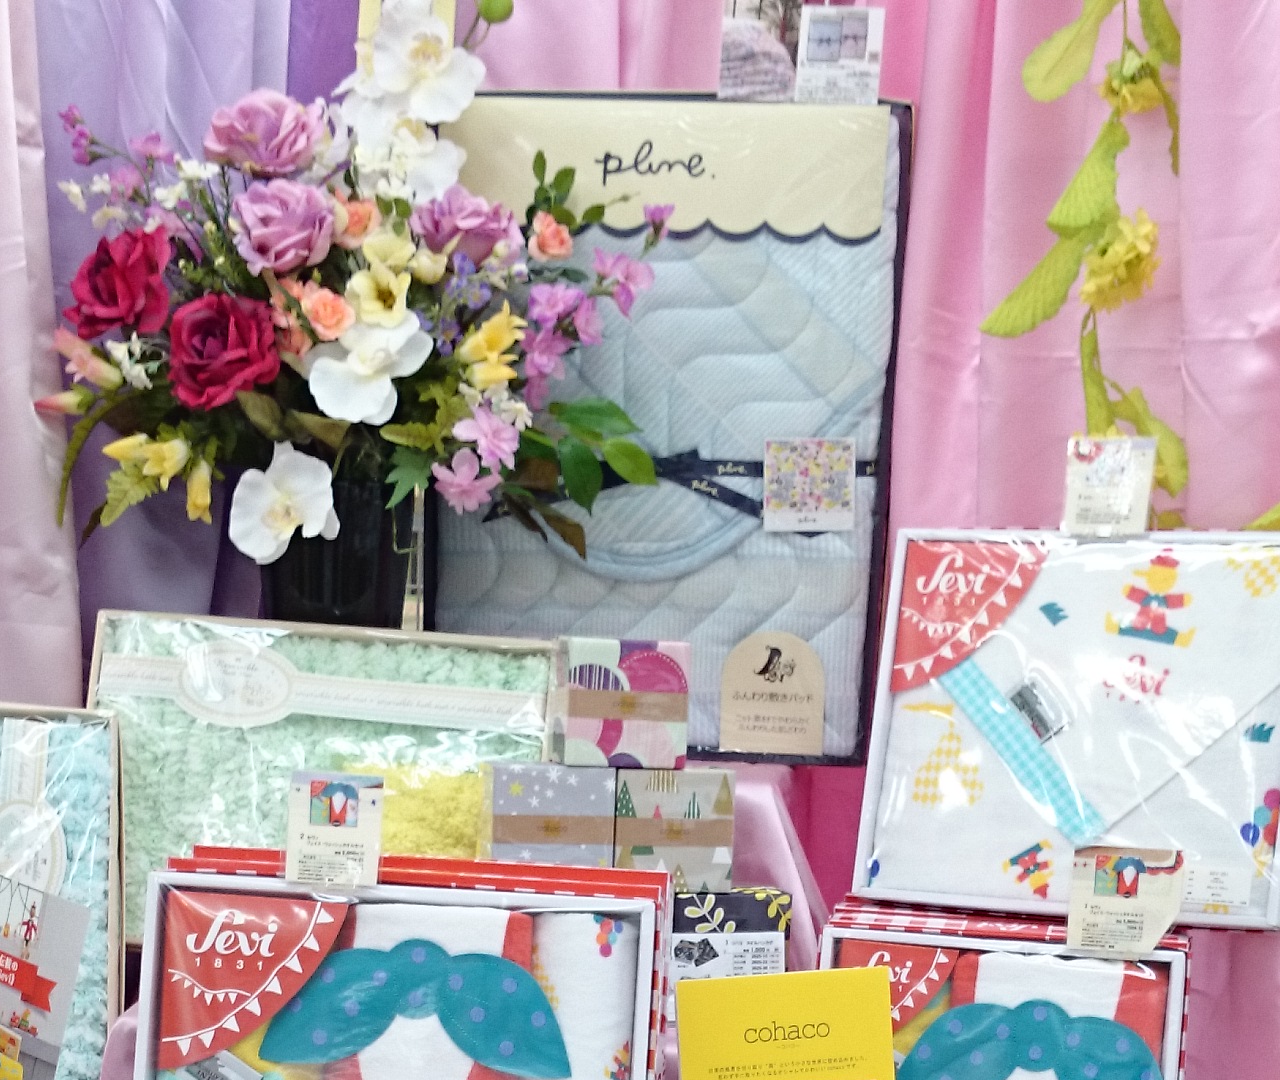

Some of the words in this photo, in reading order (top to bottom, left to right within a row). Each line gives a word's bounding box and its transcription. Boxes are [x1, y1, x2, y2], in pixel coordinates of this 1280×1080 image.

[915, 556, 988, 595] Sevi
[732, 691, 814, 703] ふんわり敷きパッド
[185, 908, 278, 958] Sevi
[194, 957, 263, 971] 1831
[744, 1021, 830, 1044] cohaco
